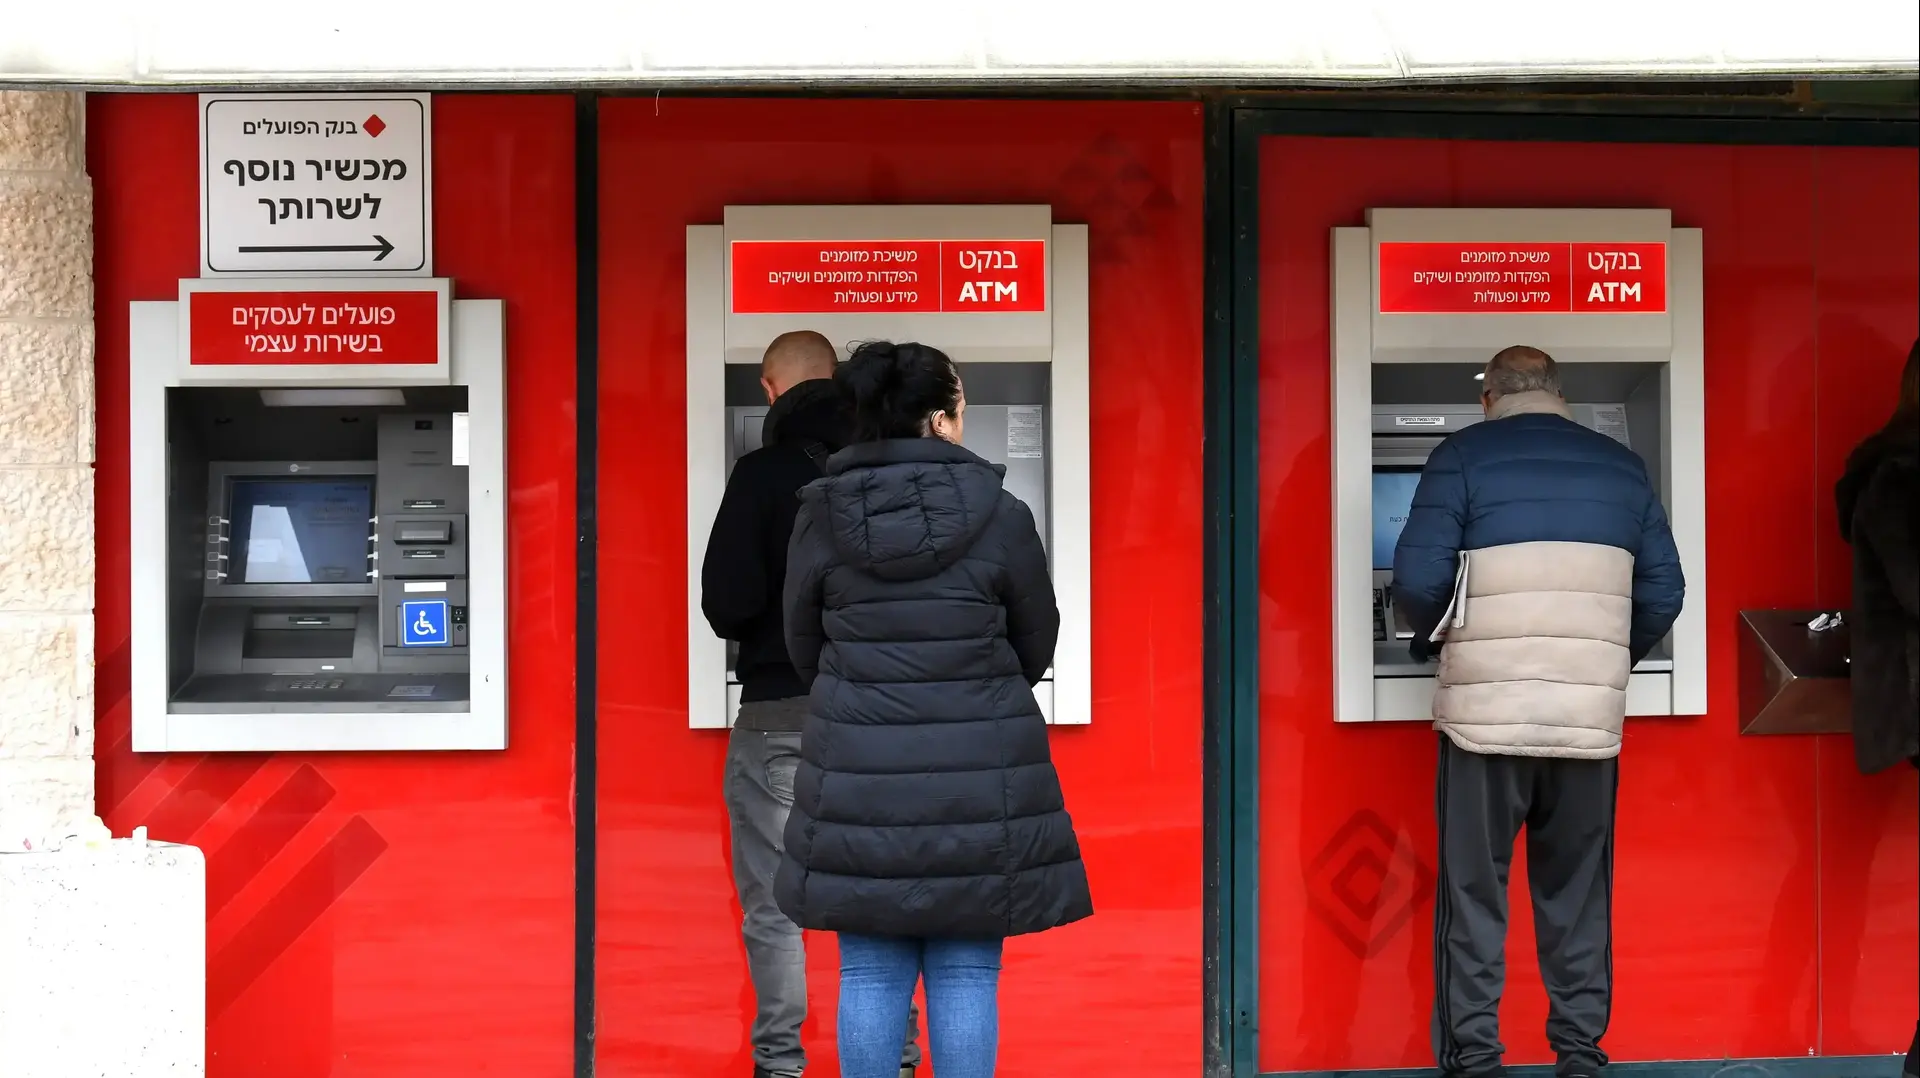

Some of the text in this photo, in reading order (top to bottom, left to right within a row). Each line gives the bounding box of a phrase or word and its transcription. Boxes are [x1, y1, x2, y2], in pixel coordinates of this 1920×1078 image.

[243, 118, 358, 138] בנק הפועלים
[223, 158, 407, 187] מכשיר נוסף
[258, 192, 382, 225] לשרותך
[820, 250, 918, 263] משיכת מזומנים
[958, 250, 1019, 274] בנקט
[1460, 251, 1550, 263] משיכת מזומנים
[1587, 251, 1642, 274] בנקט
[768, 270, 918, 285] הפקדות מזומנים ושיקים
[1413, 271, 1550, 285] הפקדות מזומנים ושיקים
[833, 289, 918, 303] מידע ופעולות
[958, 281, 1018, 302] ATM
[1473, 289, 1551, 303] מידע ופעולות
[1587, 281, 1641, 302] ATM
[232, 302, 397, 331] פועלים לעסקים
[244, 333, 383, 353] בשירות עצמי
